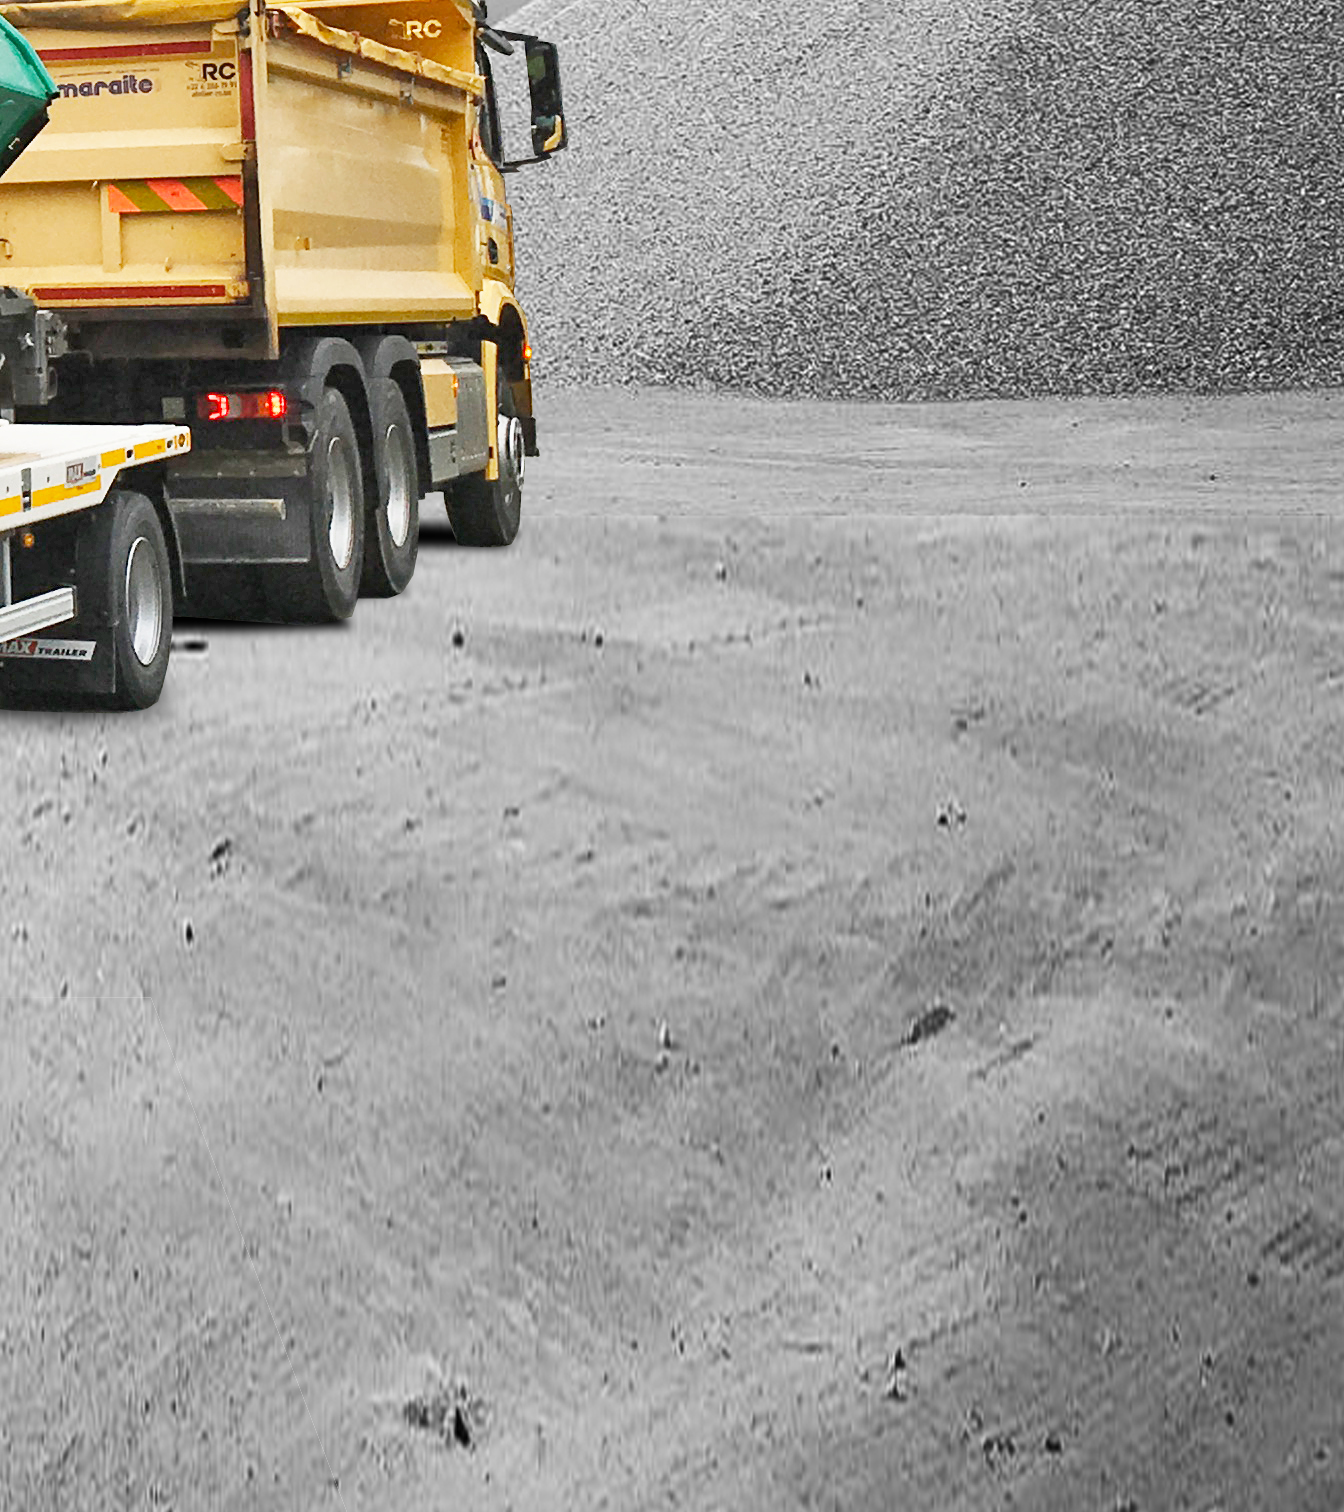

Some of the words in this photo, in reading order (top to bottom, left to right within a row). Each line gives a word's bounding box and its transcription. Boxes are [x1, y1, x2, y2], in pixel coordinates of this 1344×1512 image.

[406, 19, 442, 39] RC
[202, 62, 236, 81] RC
[38, 647, 88, 657] TRAILER
